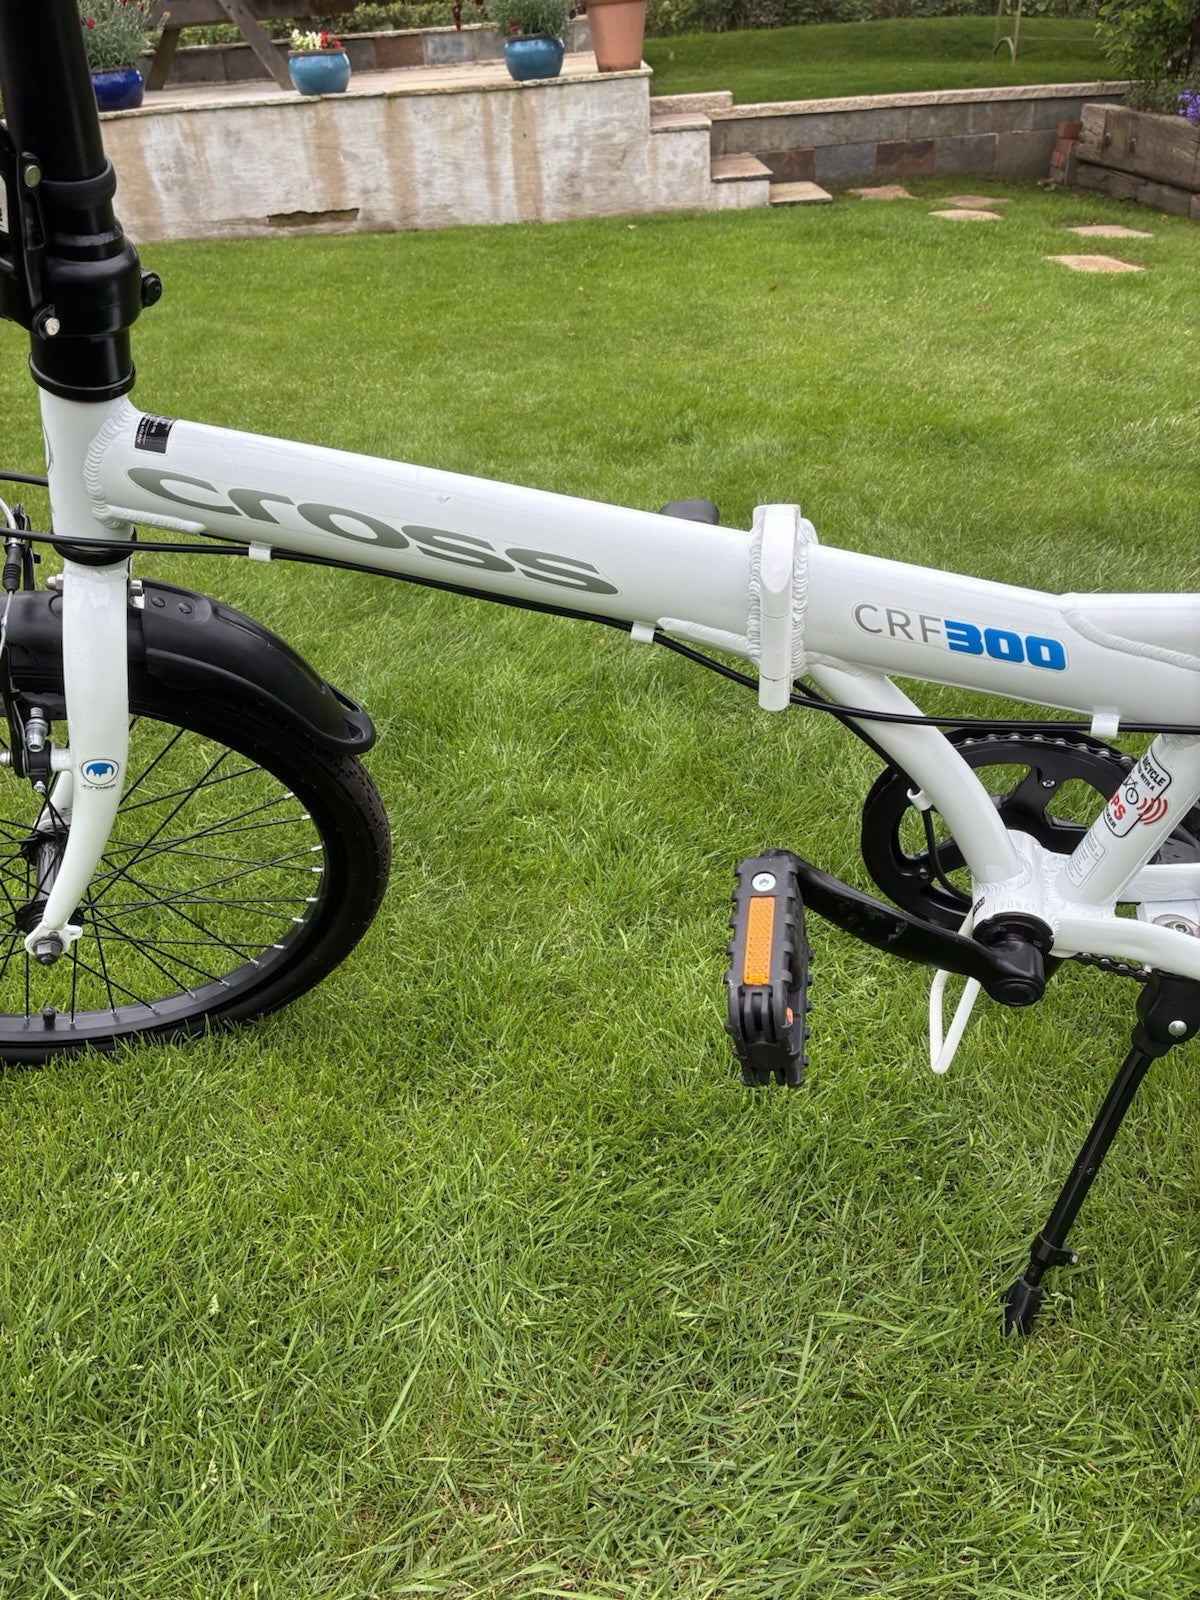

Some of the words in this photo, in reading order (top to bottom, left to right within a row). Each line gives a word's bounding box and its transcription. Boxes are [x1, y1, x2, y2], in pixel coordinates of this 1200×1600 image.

[127, 466, 619, 595] cross
[854, 603, 1066, 671] CRF300
[1111, 793, 1126, 820] PS
